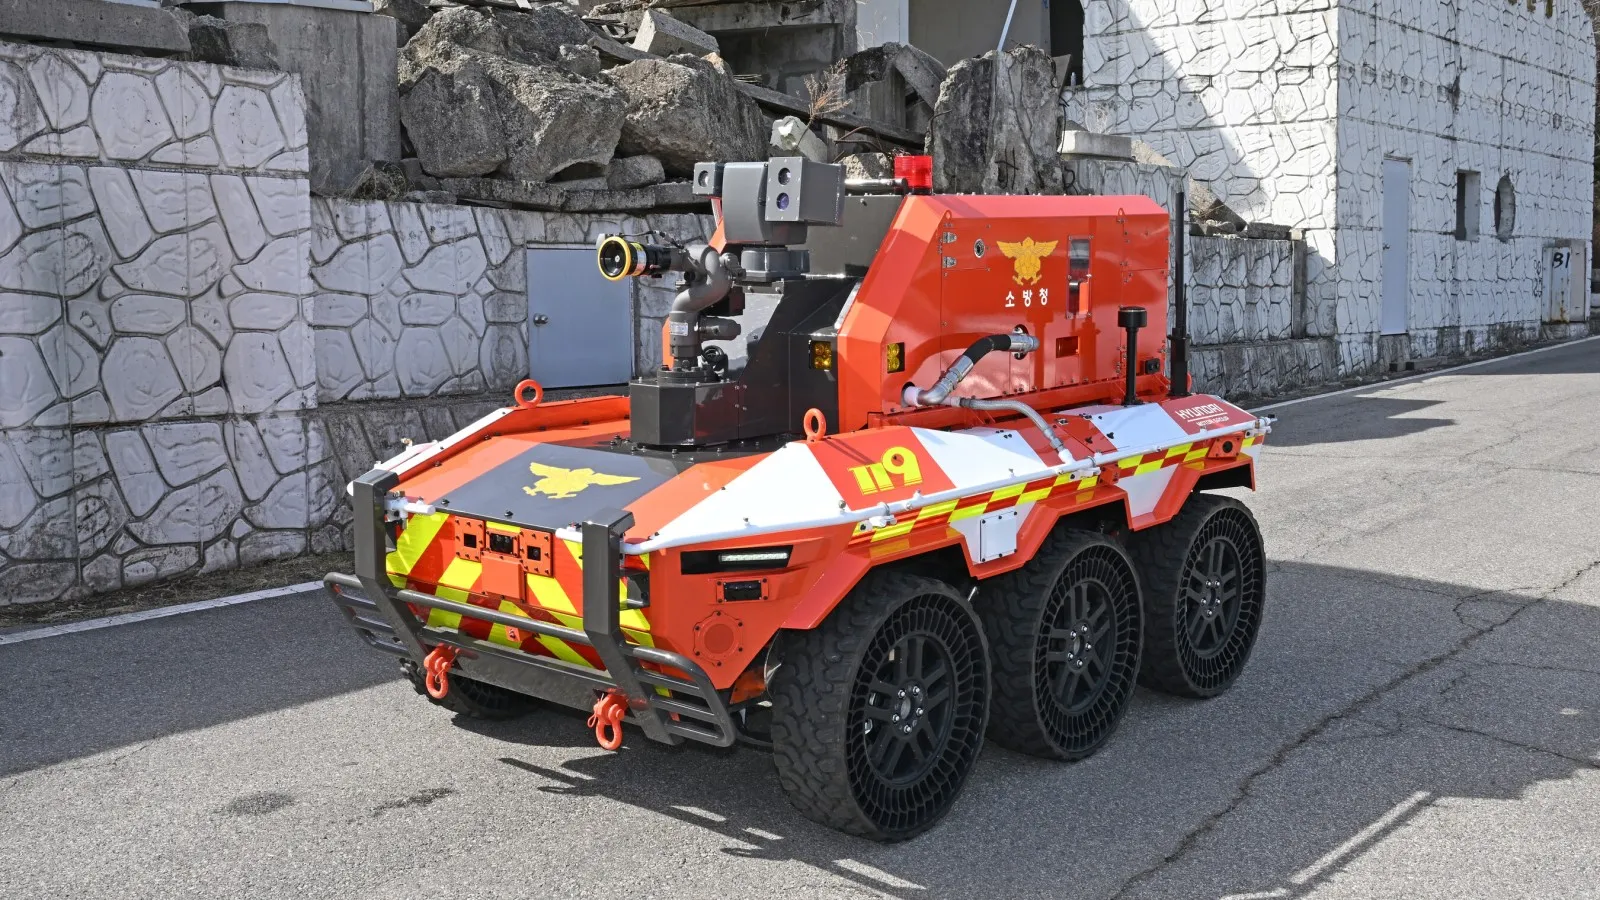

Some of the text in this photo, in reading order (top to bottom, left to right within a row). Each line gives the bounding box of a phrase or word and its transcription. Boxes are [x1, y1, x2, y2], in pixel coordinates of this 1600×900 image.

[1552, 251, 1571, 269] B1
[1175, 404, 1223, 419] HYUNDAI
[847, 446, 923, 495] 119
